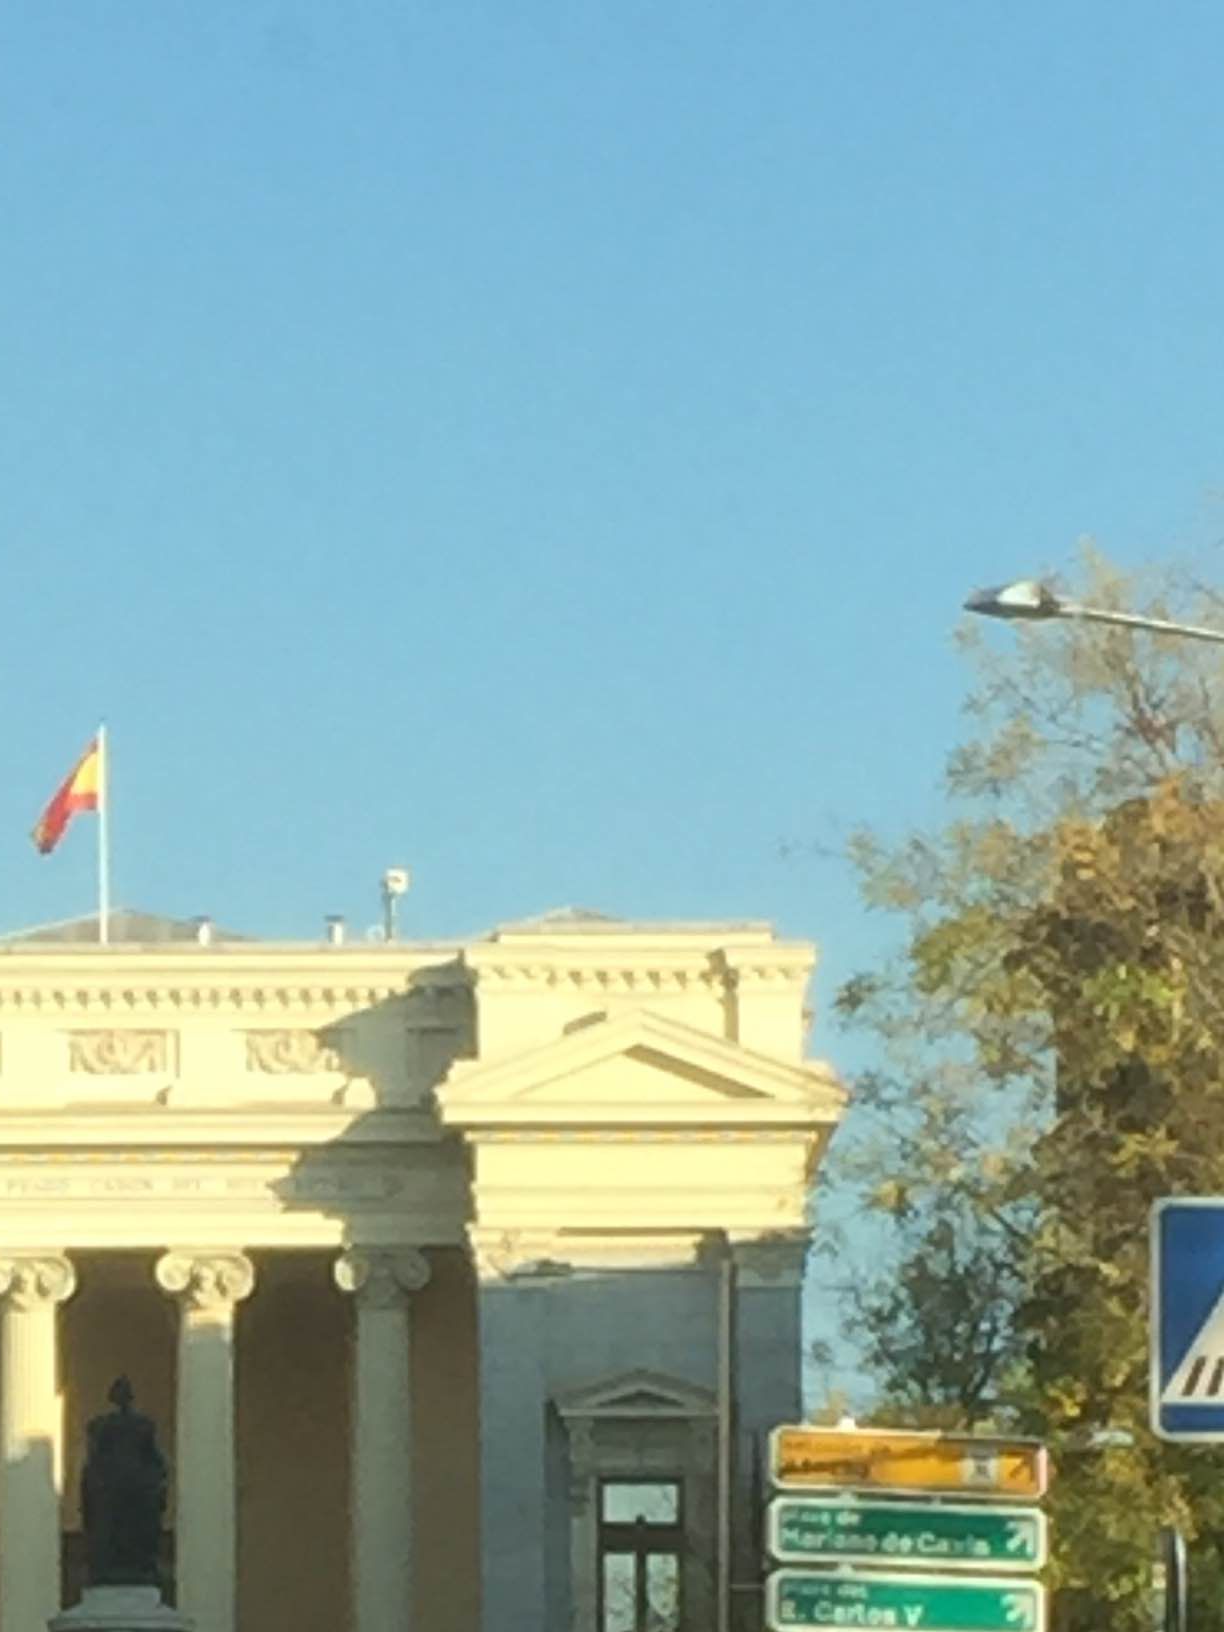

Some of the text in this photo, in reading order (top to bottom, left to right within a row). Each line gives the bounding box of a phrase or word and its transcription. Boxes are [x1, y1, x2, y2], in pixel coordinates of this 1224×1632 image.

[881, 1531, 913, 1553] de
[815, 1600, 898, 1626] Carlos
[903, 1603, 925, 1627] V
